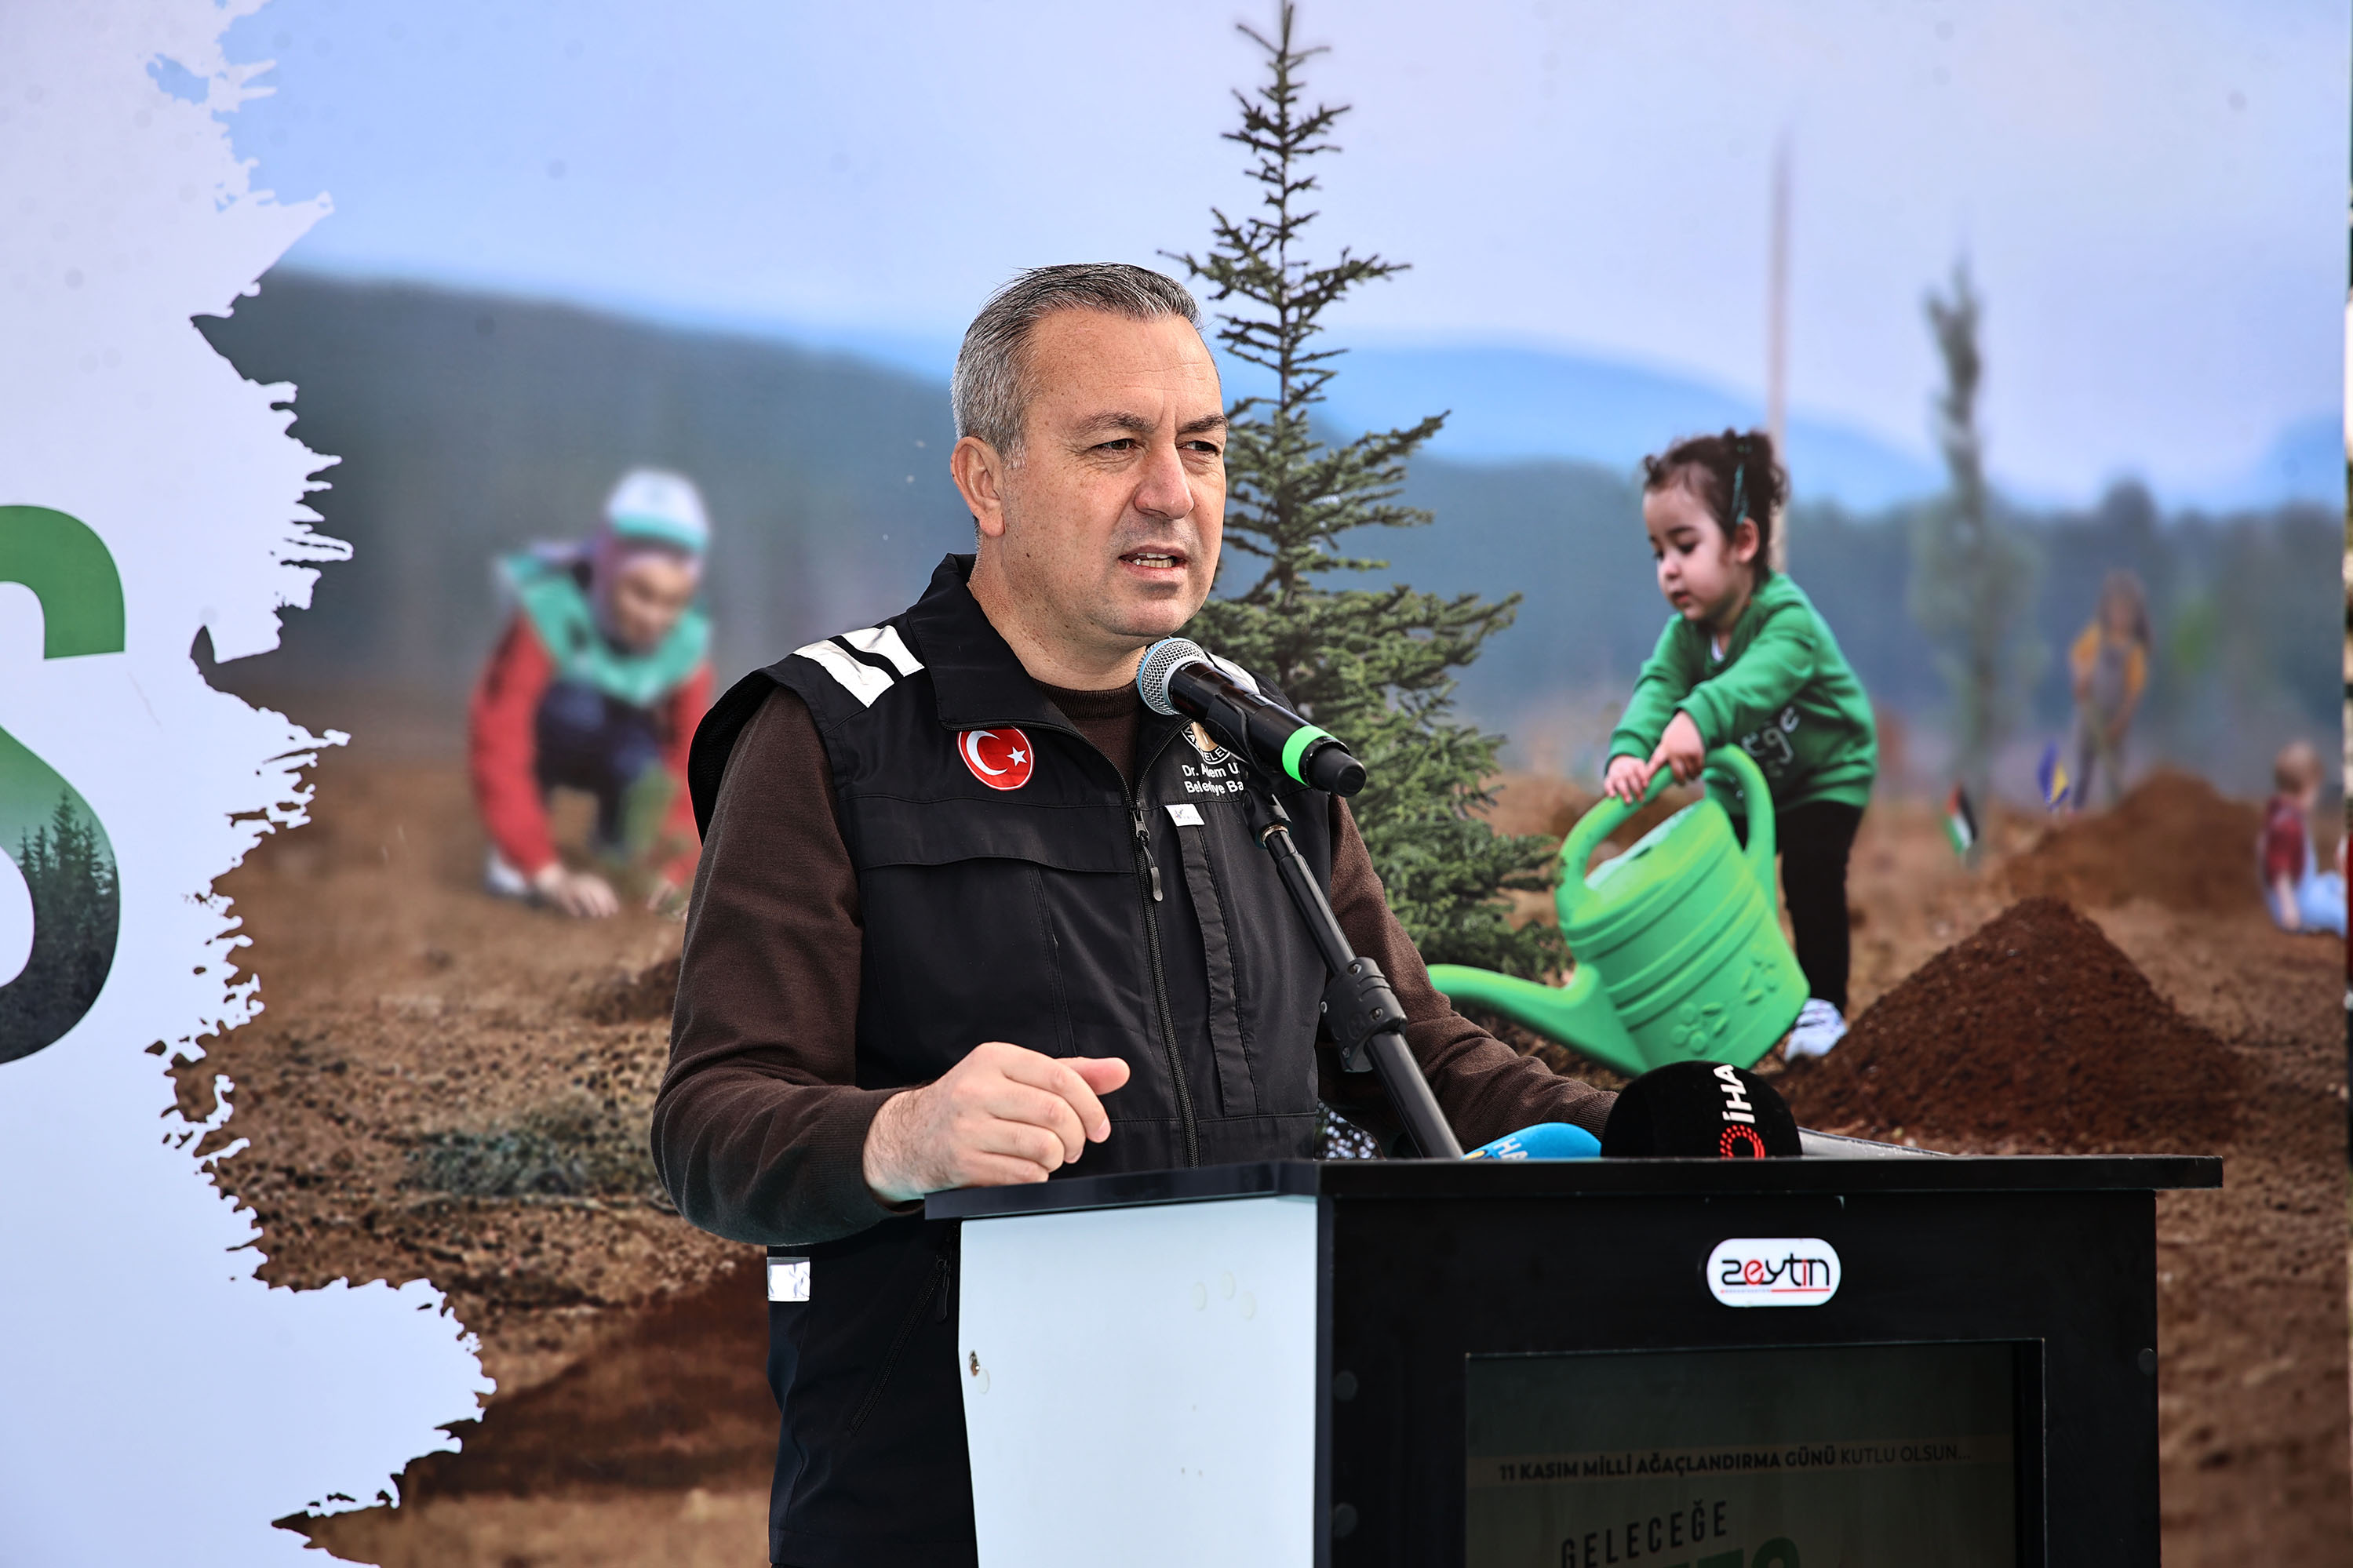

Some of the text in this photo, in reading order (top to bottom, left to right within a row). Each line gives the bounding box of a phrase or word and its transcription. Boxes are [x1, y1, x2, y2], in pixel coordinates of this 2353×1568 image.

[1182, 765, 1199, 777] Dr.
[1714, 1064, 1755, 1123] İHA
[1499, 1464, 1515, 1480] 11
[1520, 1461, 1578, 1480] KASIM
[1583, 1453, 1632, 1476] MİLLİ
[1636, 1452, 1781, 1477] AĞAÇLANDIRMA
[1785, 1446, 1836, 1467] GÜNÜ
[1841, 1447, 1896, 1464] KUTLU
[1561, 1499, 1728, 1568] GELECEĞE
